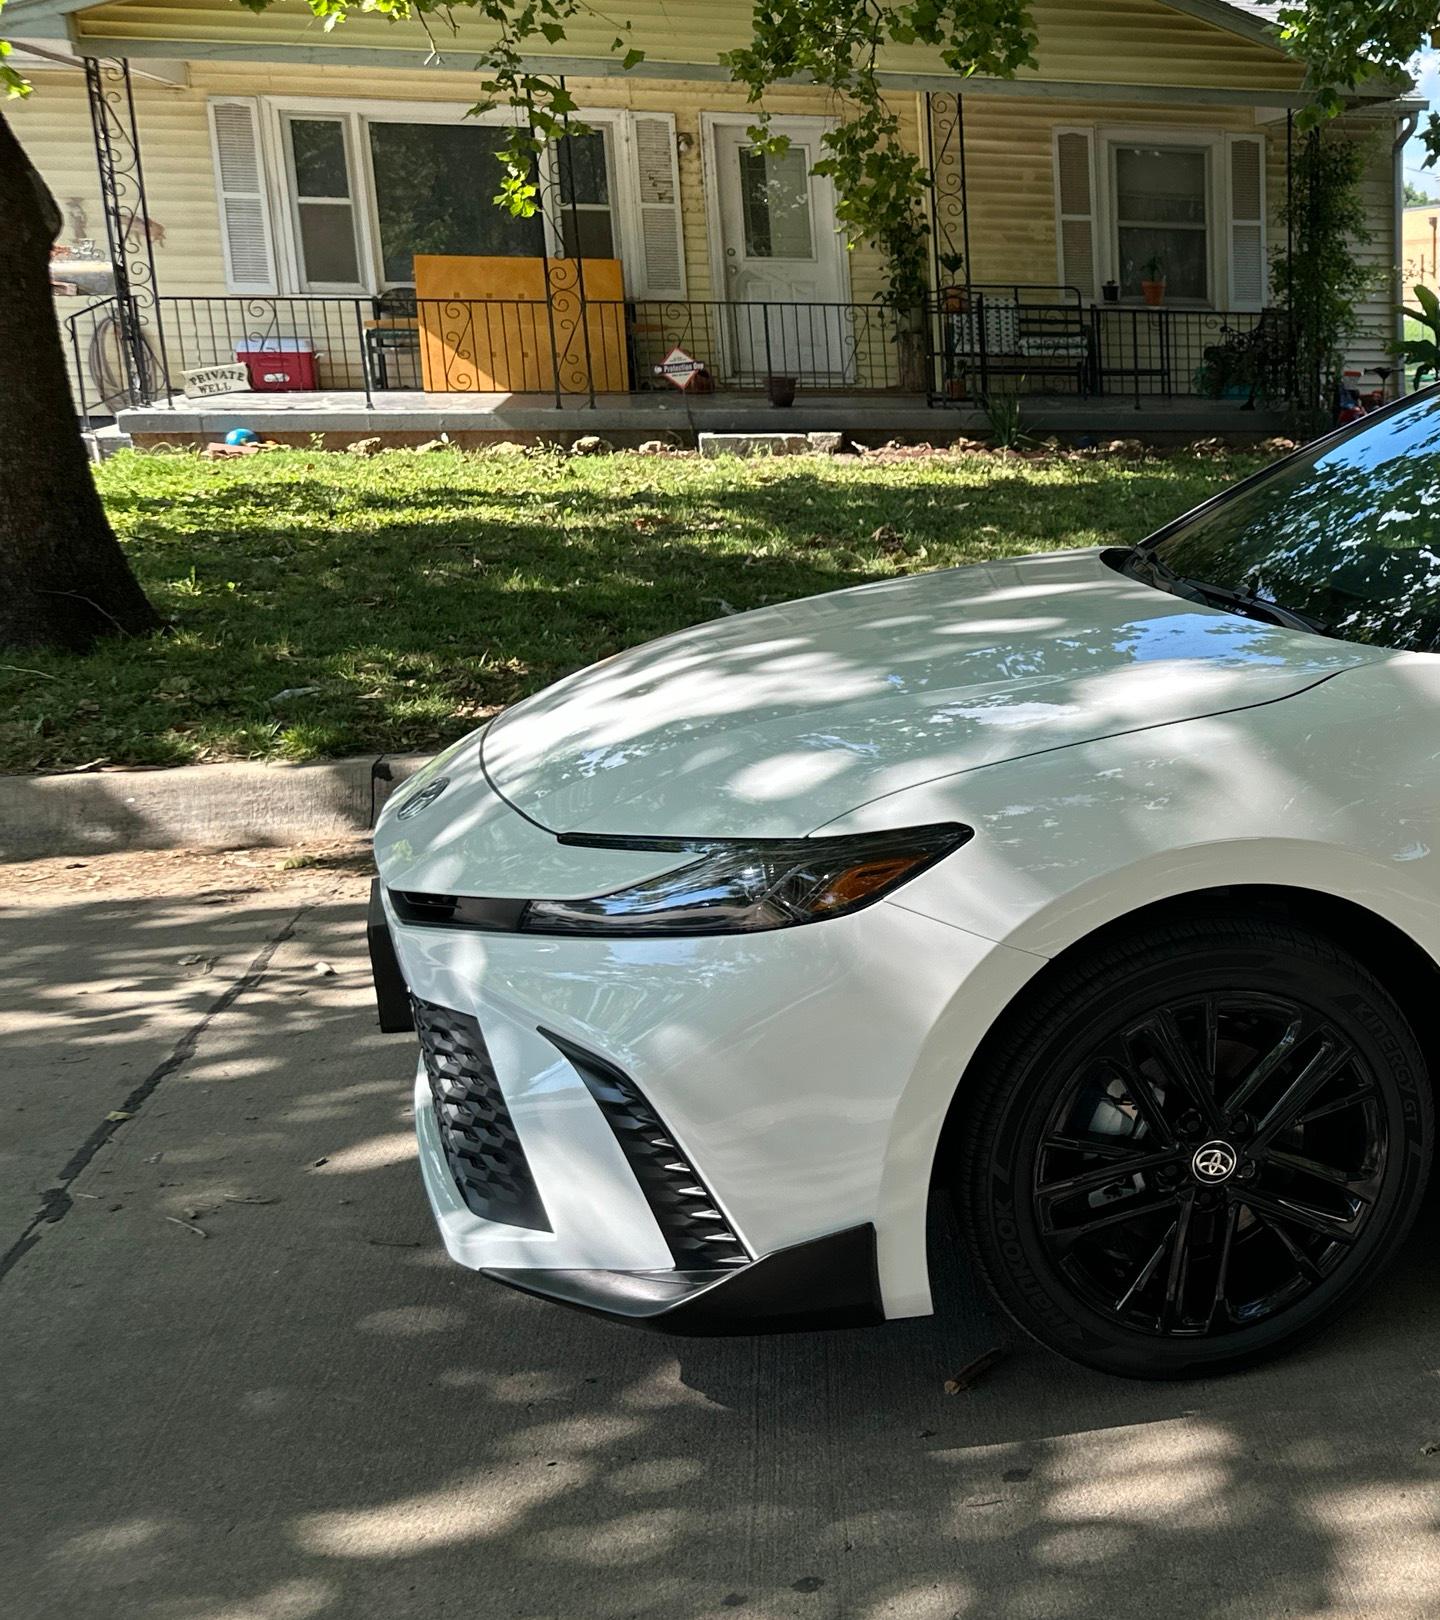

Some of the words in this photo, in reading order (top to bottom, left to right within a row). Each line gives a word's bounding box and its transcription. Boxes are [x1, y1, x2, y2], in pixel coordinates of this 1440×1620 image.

[188, 371, 245, 385] PRIVATE
[198, 382, 231, 394] WELL
[1403, 1098, 1419, 1125] GT
